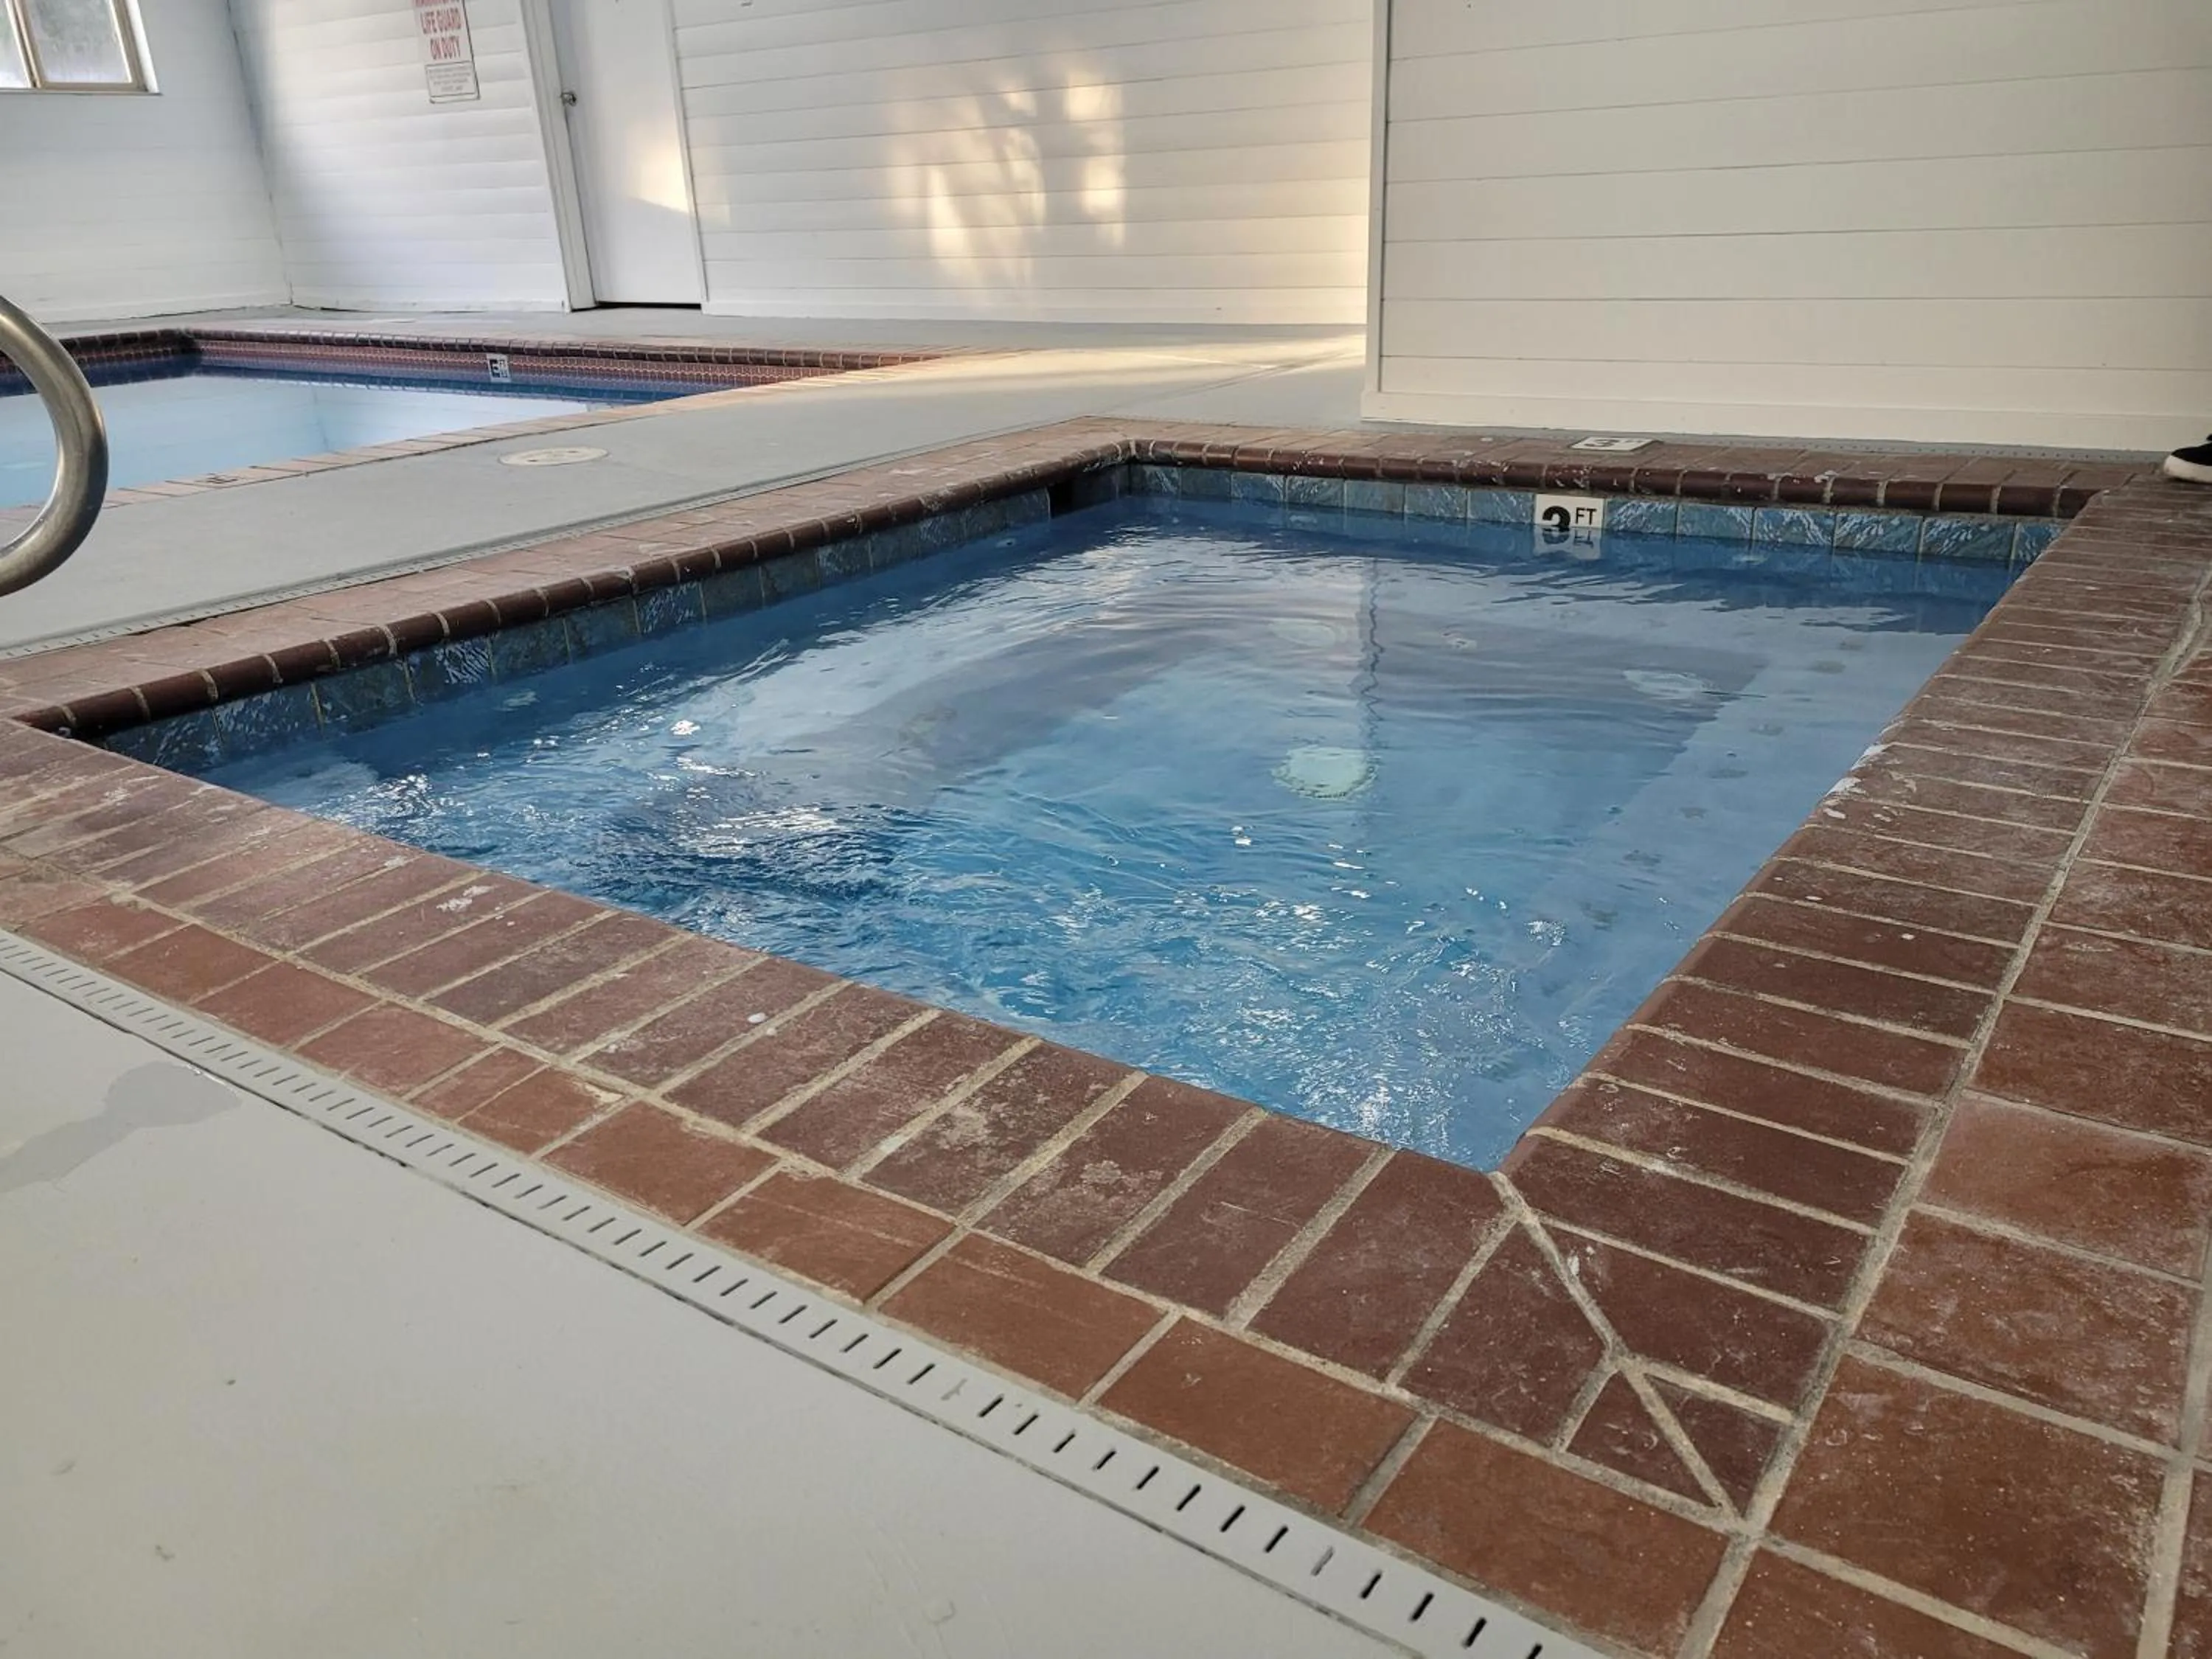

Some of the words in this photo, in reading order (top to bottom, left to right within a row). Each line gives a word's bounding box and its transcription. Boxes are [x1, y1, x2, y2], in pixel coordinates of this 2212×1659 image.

[420, 10, 437, 34] LIFE
[436, 7, 461, 32] GUARD
[430, 38, 443, 60] ON
[442, 35, 460, 59] DUTY
[1584, 439, 1620, 447] 3
[1576, 507, 1597, 525] FT
